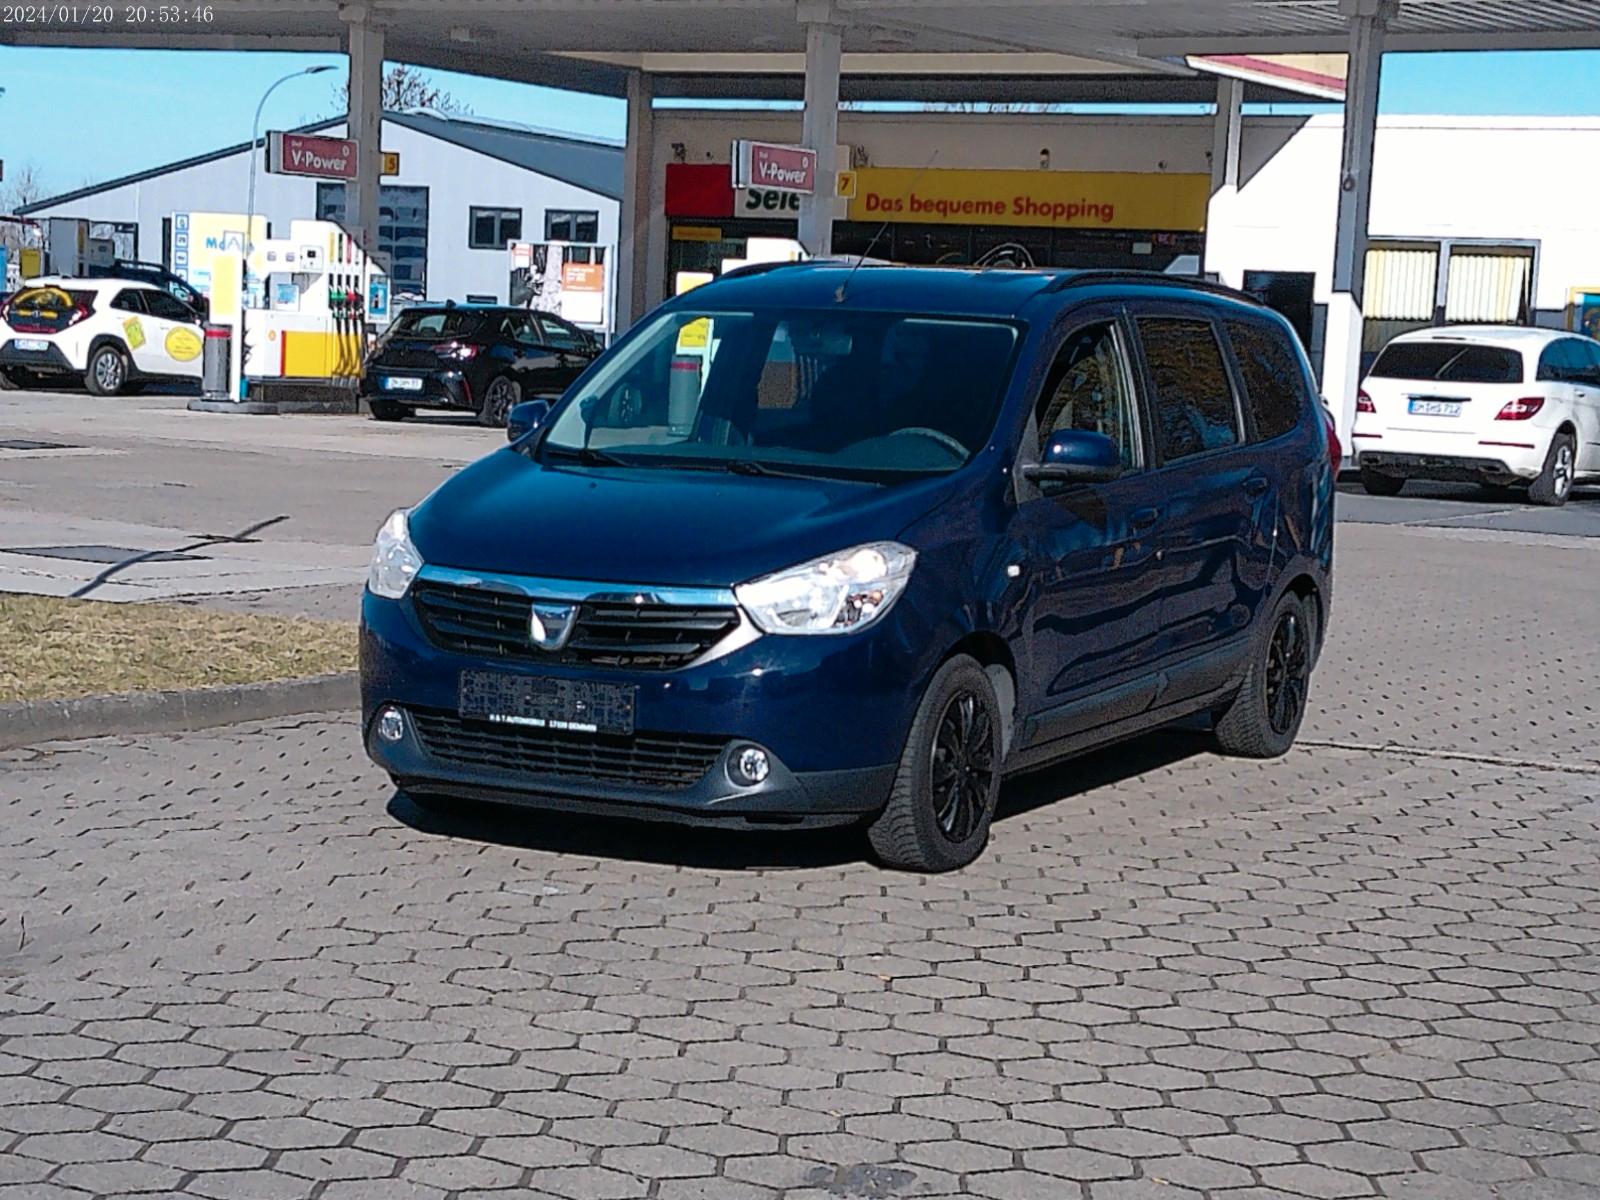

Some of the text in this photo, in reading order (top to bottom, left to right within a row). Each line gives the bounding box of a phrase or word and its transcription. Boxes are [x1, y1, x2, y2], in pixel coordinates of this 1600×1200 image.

[291, 149, 347, 171] V-Power
[759, 161, 807, 184] V-Power
[841, 176, 850, 191] 7
[865, 192, 1115, 224] Das bequeme Shopping
